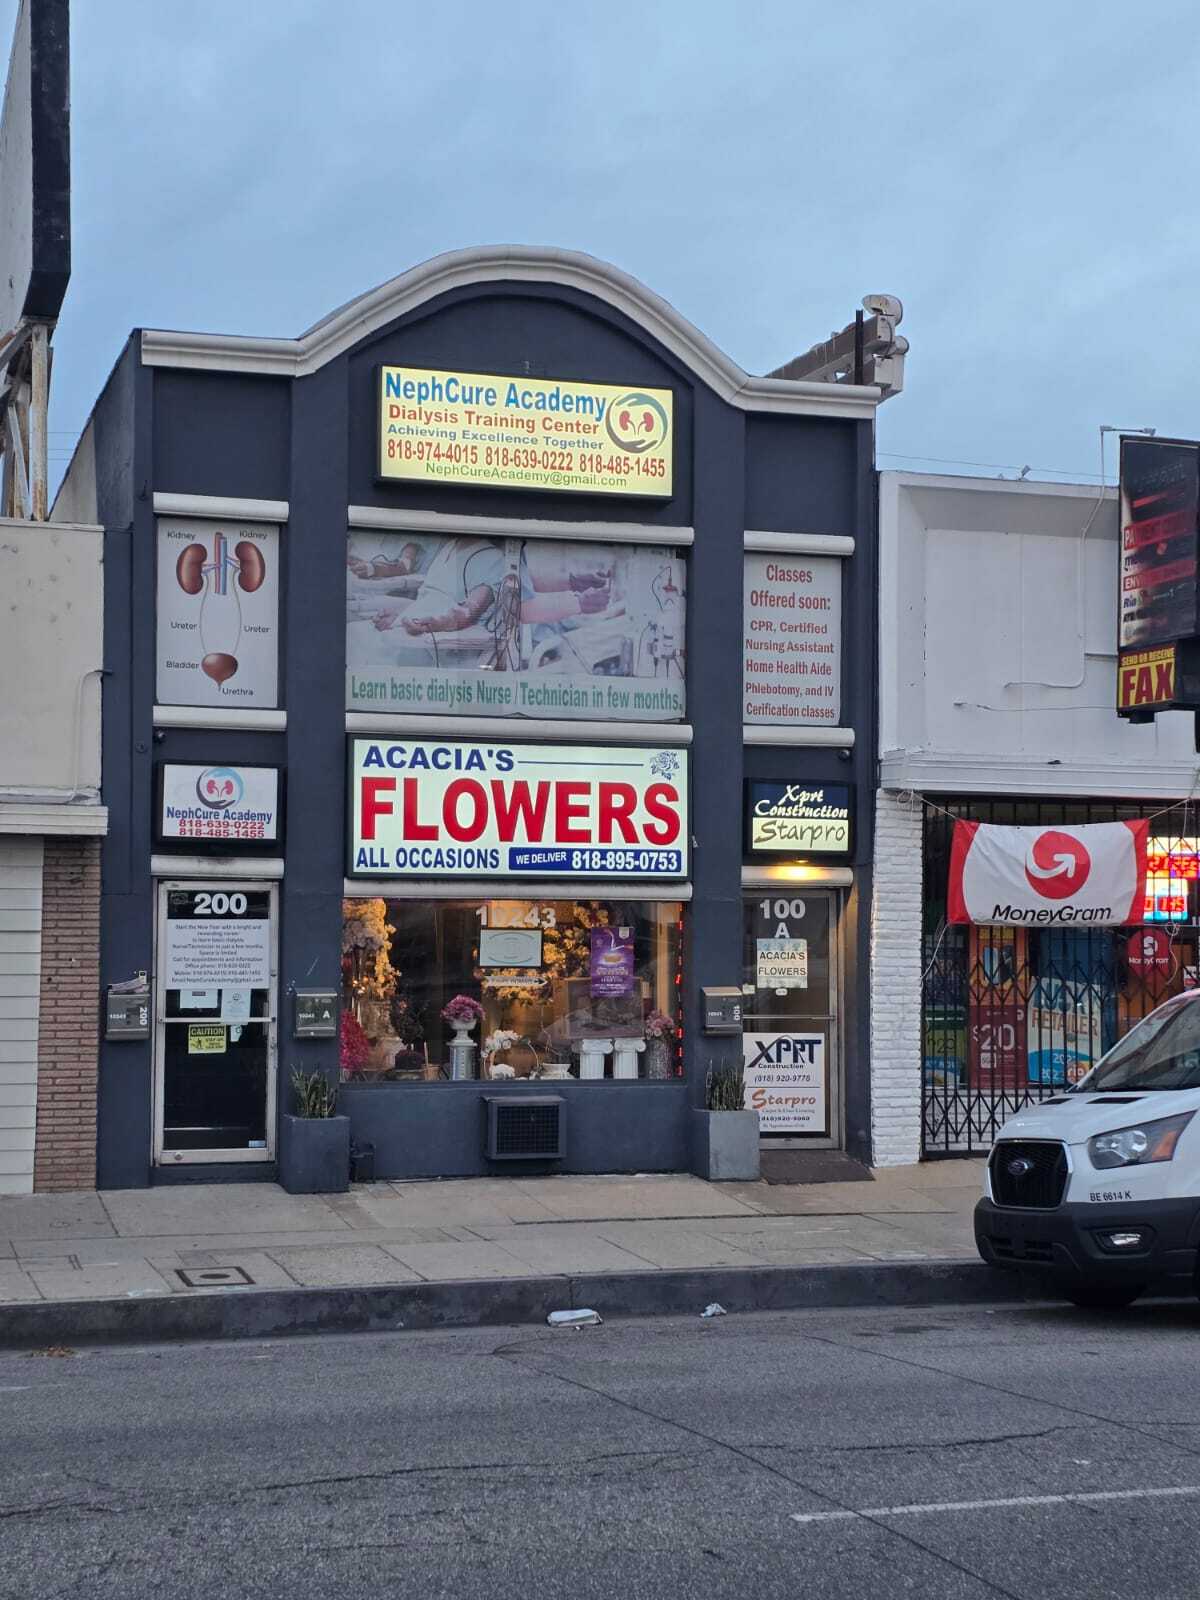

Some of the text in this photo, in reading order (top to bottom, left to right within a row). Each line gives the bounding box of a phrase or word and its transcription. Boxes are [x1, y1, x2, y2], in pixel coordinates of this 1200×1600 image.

[385, 372, 606, 421] NephCure Academy
[388, 404, 600, 434] Dialysis Training Center
[388, 424, 604, 450] Achieving Excellence Together
[387, 439, 665, 477] 818-974-4015 818-639-0222 818-485-1455
[425, 461, 627, 487] NephCureAcademy@gmail.com
[168, 530, 197, 541] Kidney
[240, 530, 268, 540] Kidney
[766, 564, 813, 583] Classes
[750, 590, 831, 611] Offered soon:
[170, 621, 197, 630] Ureter
[244, 625, 270, 633] Ureter
[750, 620, 828, 634] CPR, Certified
[746, 639, 834, 654] Nursing Assistant
[166, 661, 200, 670] Bladder
[746, 659, 832, 675] Home Health Aide
[222, 688, 254, 697] Urethra
[746, 682, 835, 698] Phlebotomy, and IV
[1122, 661, 1174, 706] FAX
[351, 676, 683, 711] Learn basic dialysis Nurse Technician in few months.
[746, 702, 835, 719] Cerification classes
[362, 746, 514, 772] ACACIA'S
[778, 785, 824, 807] Xprt
[166, 806, 272, 824] NephCure Academy
[361, 777, 681, 846] FLOWERS
[755, 799, 848, 818] Construction
[178, 819, 265, 829] 818-639-0222
[178, 828, 265, 838] 818-485-1455
[754, 820, 846, 848] Starpro
[356, 847, 500, 869] ALL OCCASIONS
[515, 851, 567, 865] WE DELIVER
[571, 851, 678, 871] 818-895-0753
[193, 893, 248, 915] 200
[759, 899, 806, 919] 100
[991, 904, 1112, 923] MoneyGram
[774, 922, 790, 938] A
[759, 951, 805, 961] ACACIA'S
[758, 967, 806, 976] FLOWERS
[1031, 1007, 1098, 1036] RETAILER
[190, 1027, 225, 1036] CAUTION
[752, 1088, 817, 1110] Starpro
[1089, 1192, 1101, 1201] BE
[1124, 1190, 1133, 1199] K
